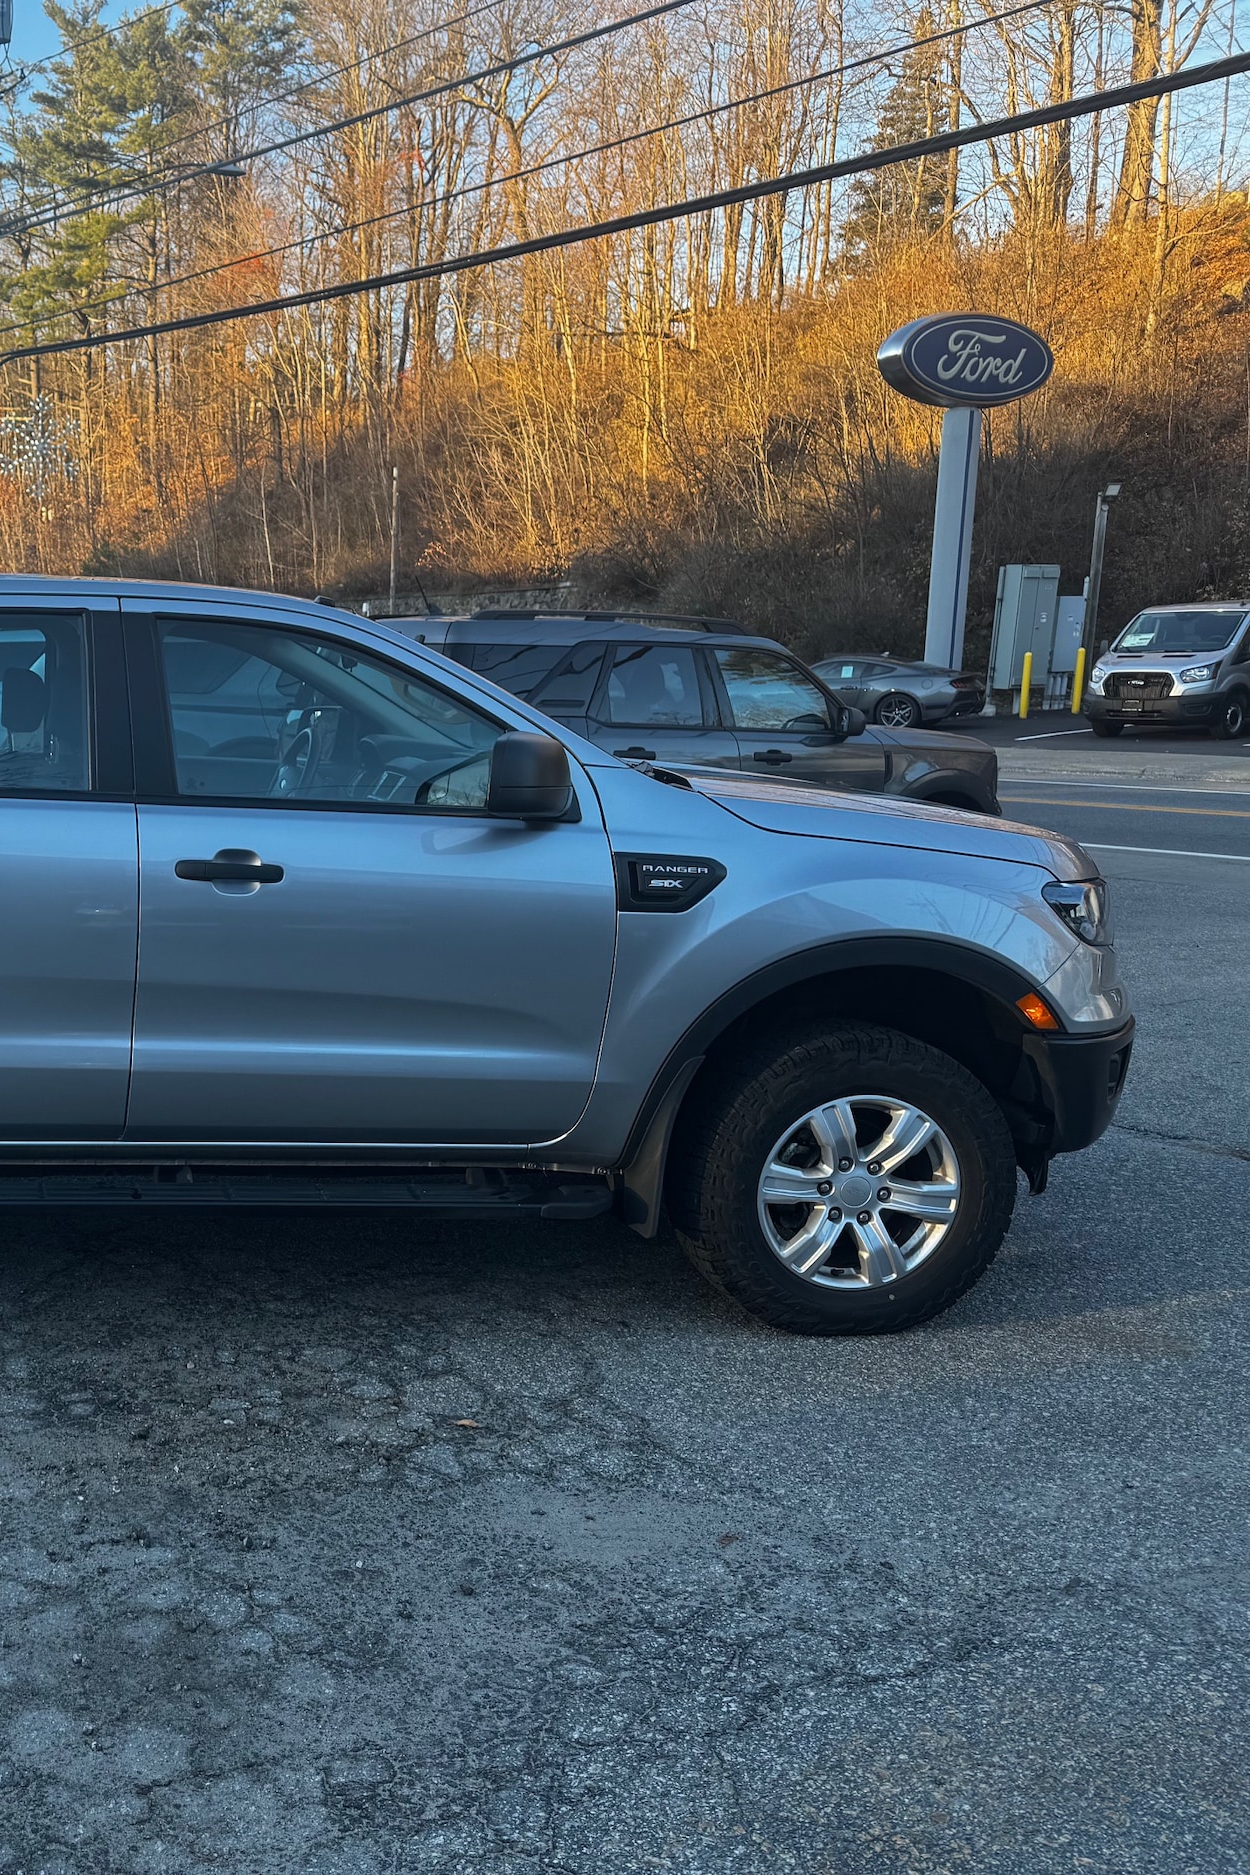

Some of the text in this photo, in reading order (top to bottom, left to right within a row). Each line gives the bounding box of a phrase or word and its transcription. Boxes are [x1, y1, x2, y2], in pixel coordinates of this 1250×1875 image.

[937, 329, 1027, 385] Ford
[642, 864, 709, 874] RANGER
[648, 879, 684, 889] STX
